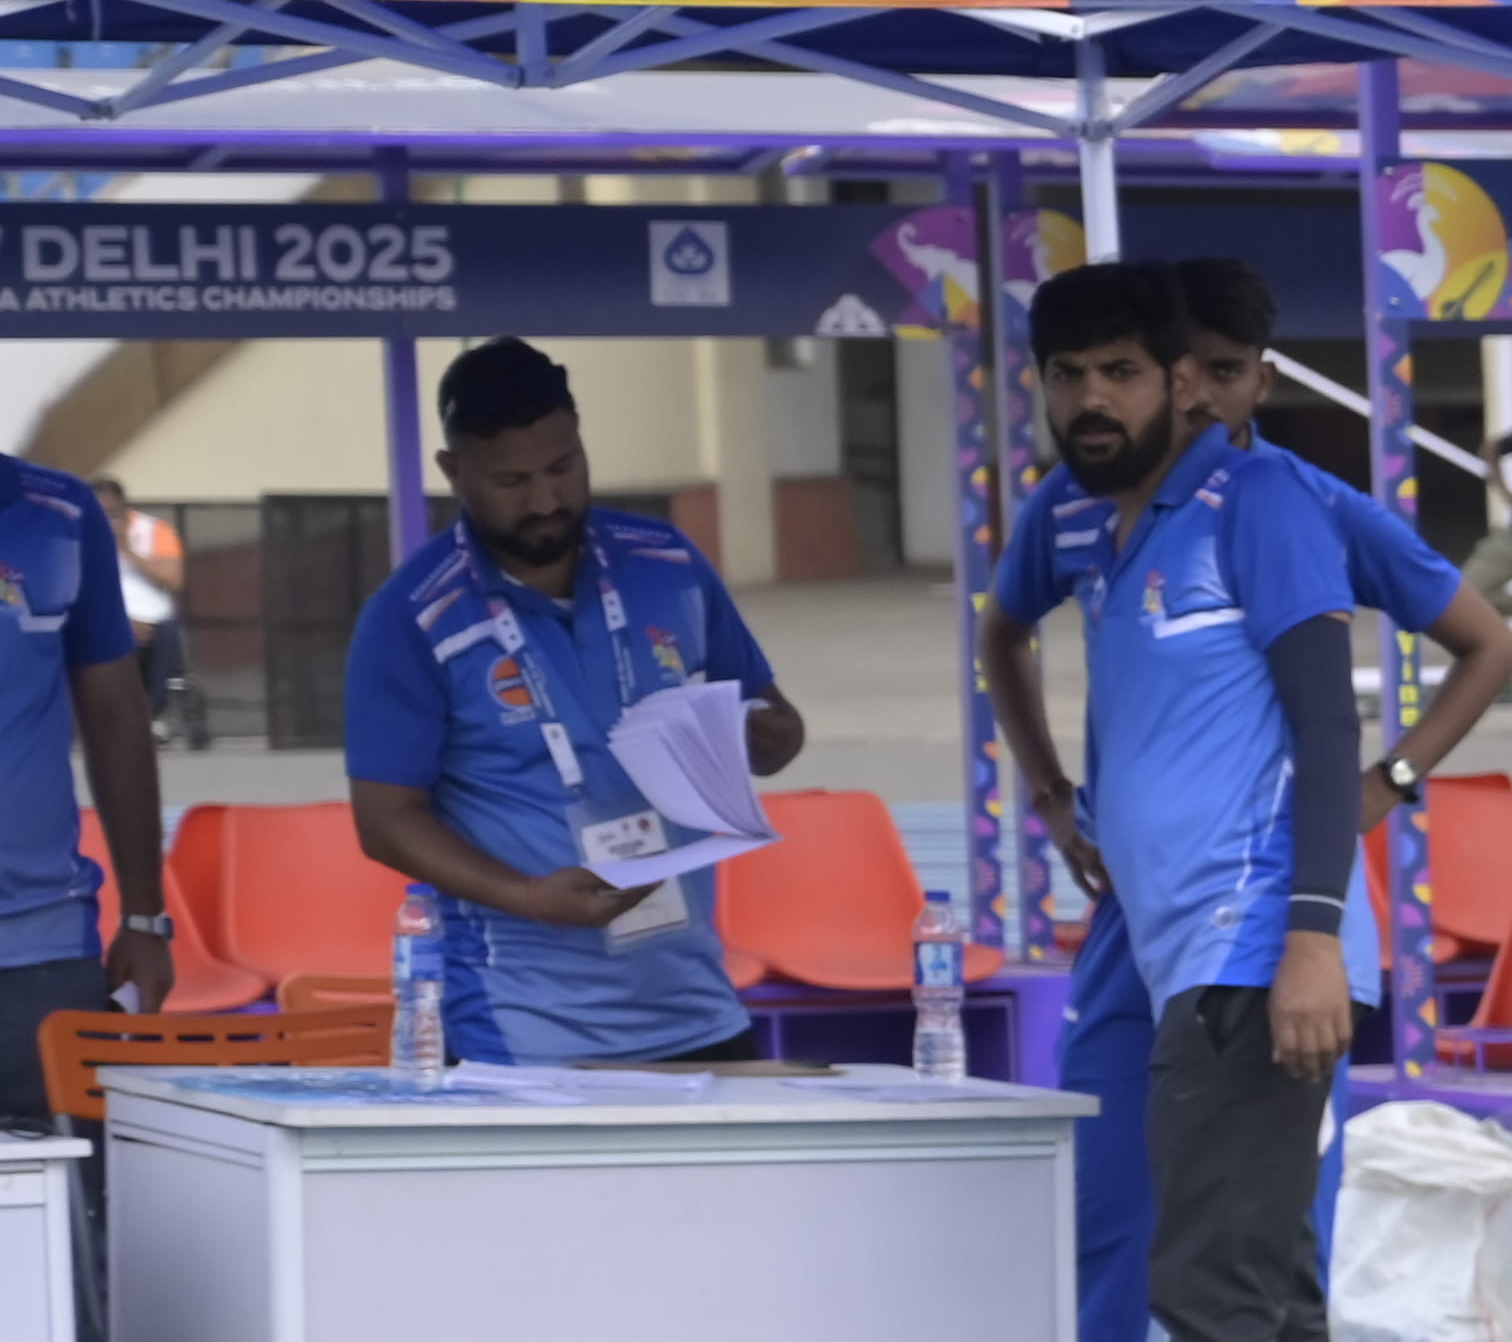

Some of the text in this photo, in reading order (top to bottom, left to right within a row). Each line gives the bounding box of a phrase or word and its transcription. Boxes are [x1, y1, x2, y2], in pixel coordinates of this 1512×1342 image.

[22, 224, 454, 283] DELHI 2025
[26, 287, 197, 311] ATHLETICS
[203, 287, 456, 312] CHAMPIONSHIPS
